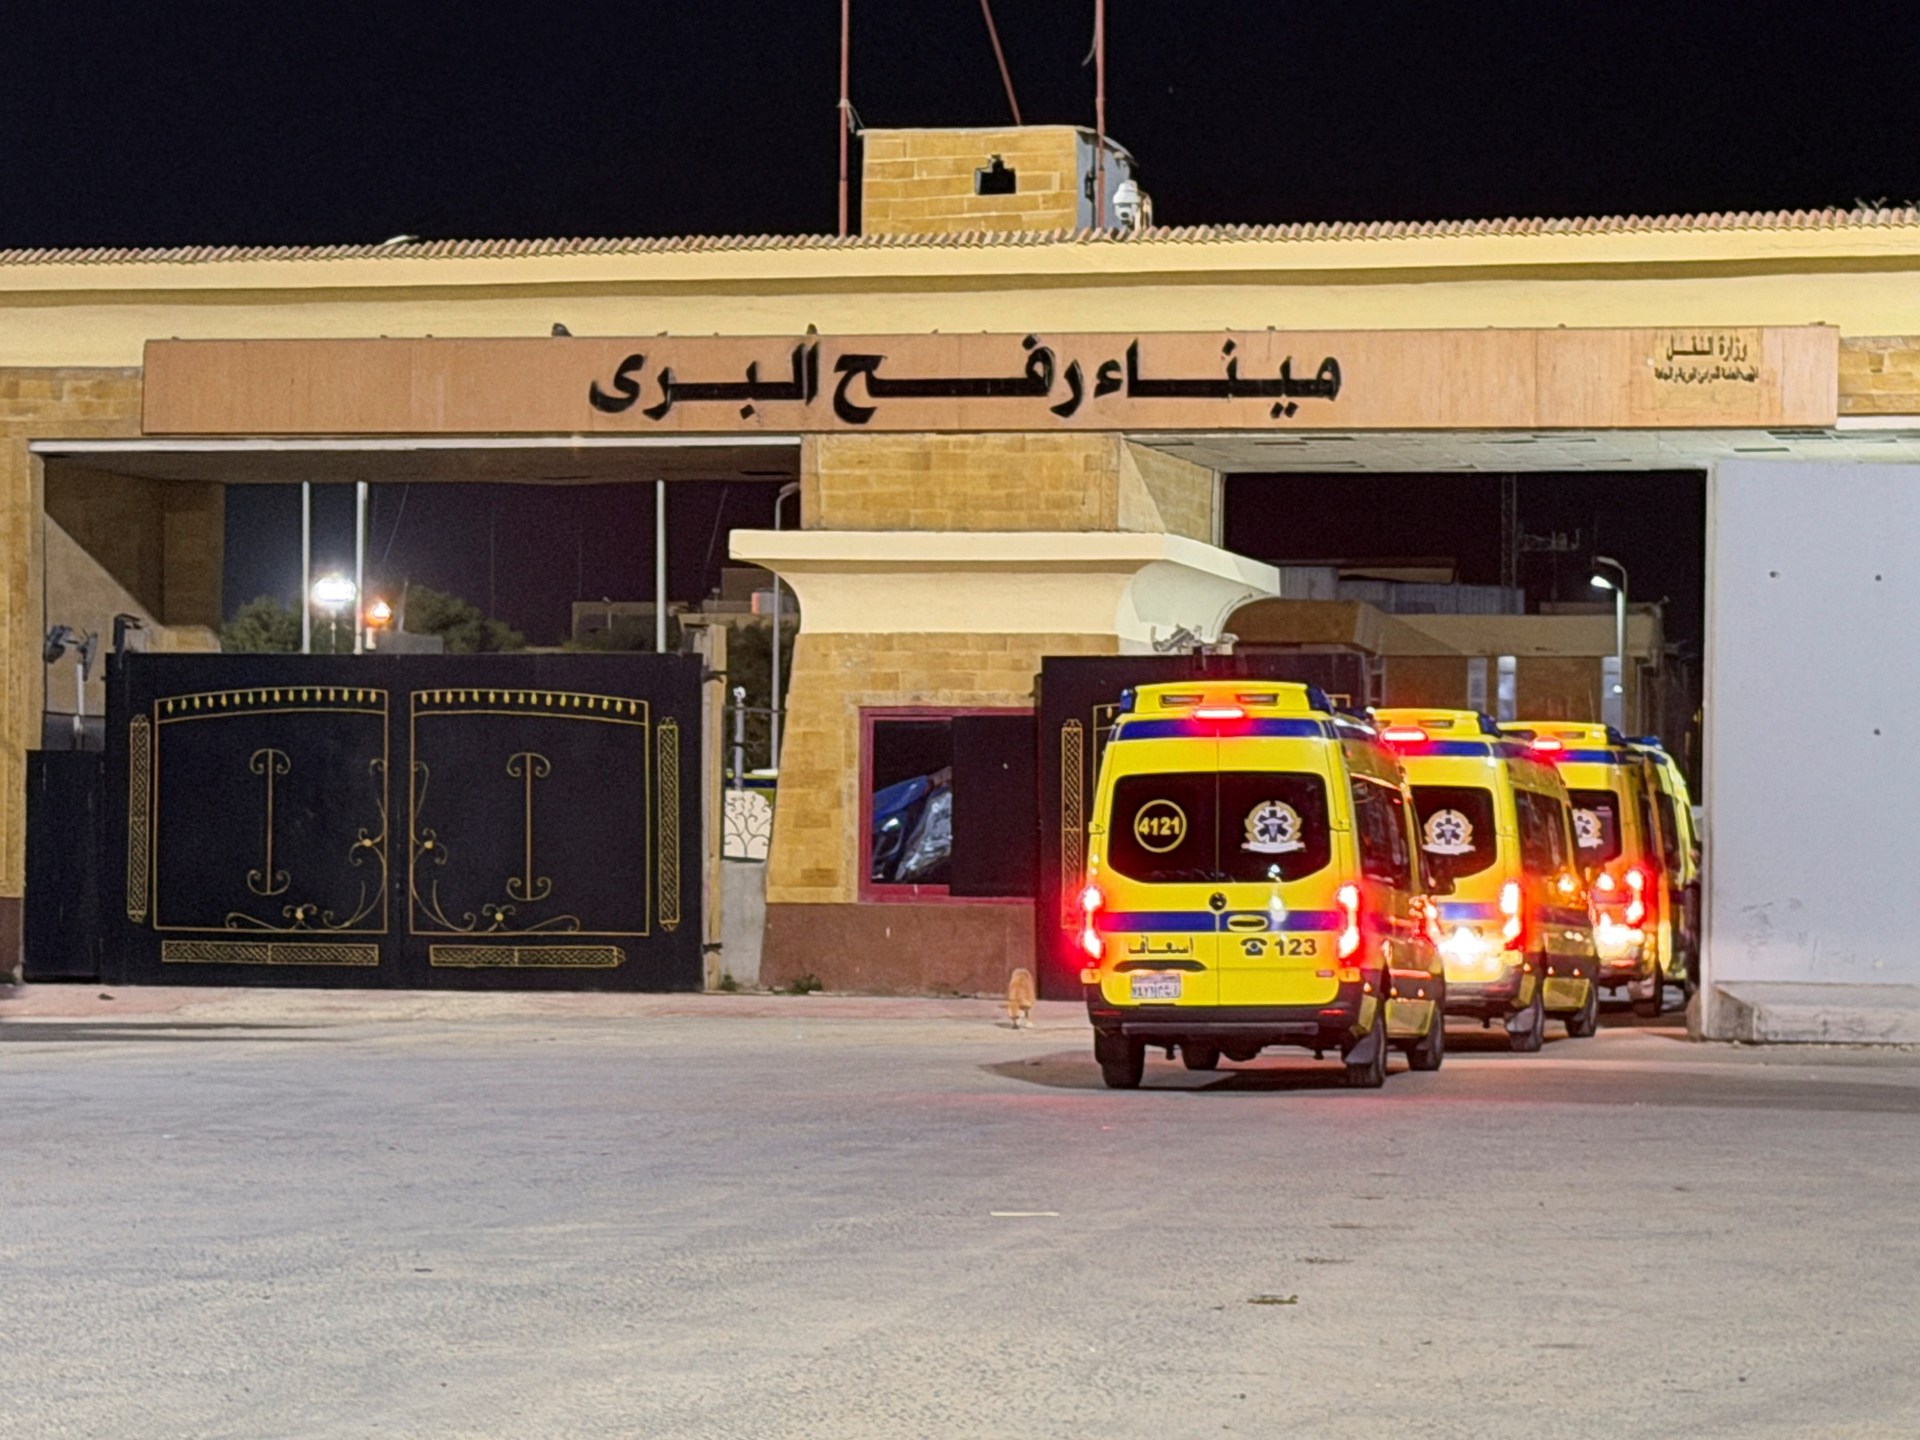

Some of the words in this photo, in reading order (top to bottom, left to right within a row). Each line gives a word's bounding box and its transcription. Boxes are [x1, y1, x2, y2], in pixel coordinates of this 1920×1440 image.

[1666, 334, 1713, 361] النقل
[1718, 335, 1747, 362] وزارة
[833, 334, 1083, 424] رفح
[1094, 337, 1341, 419] ميناء
[1139, 816, 1179, 836] 4121
[1274, 938, 1317, 957] 123
